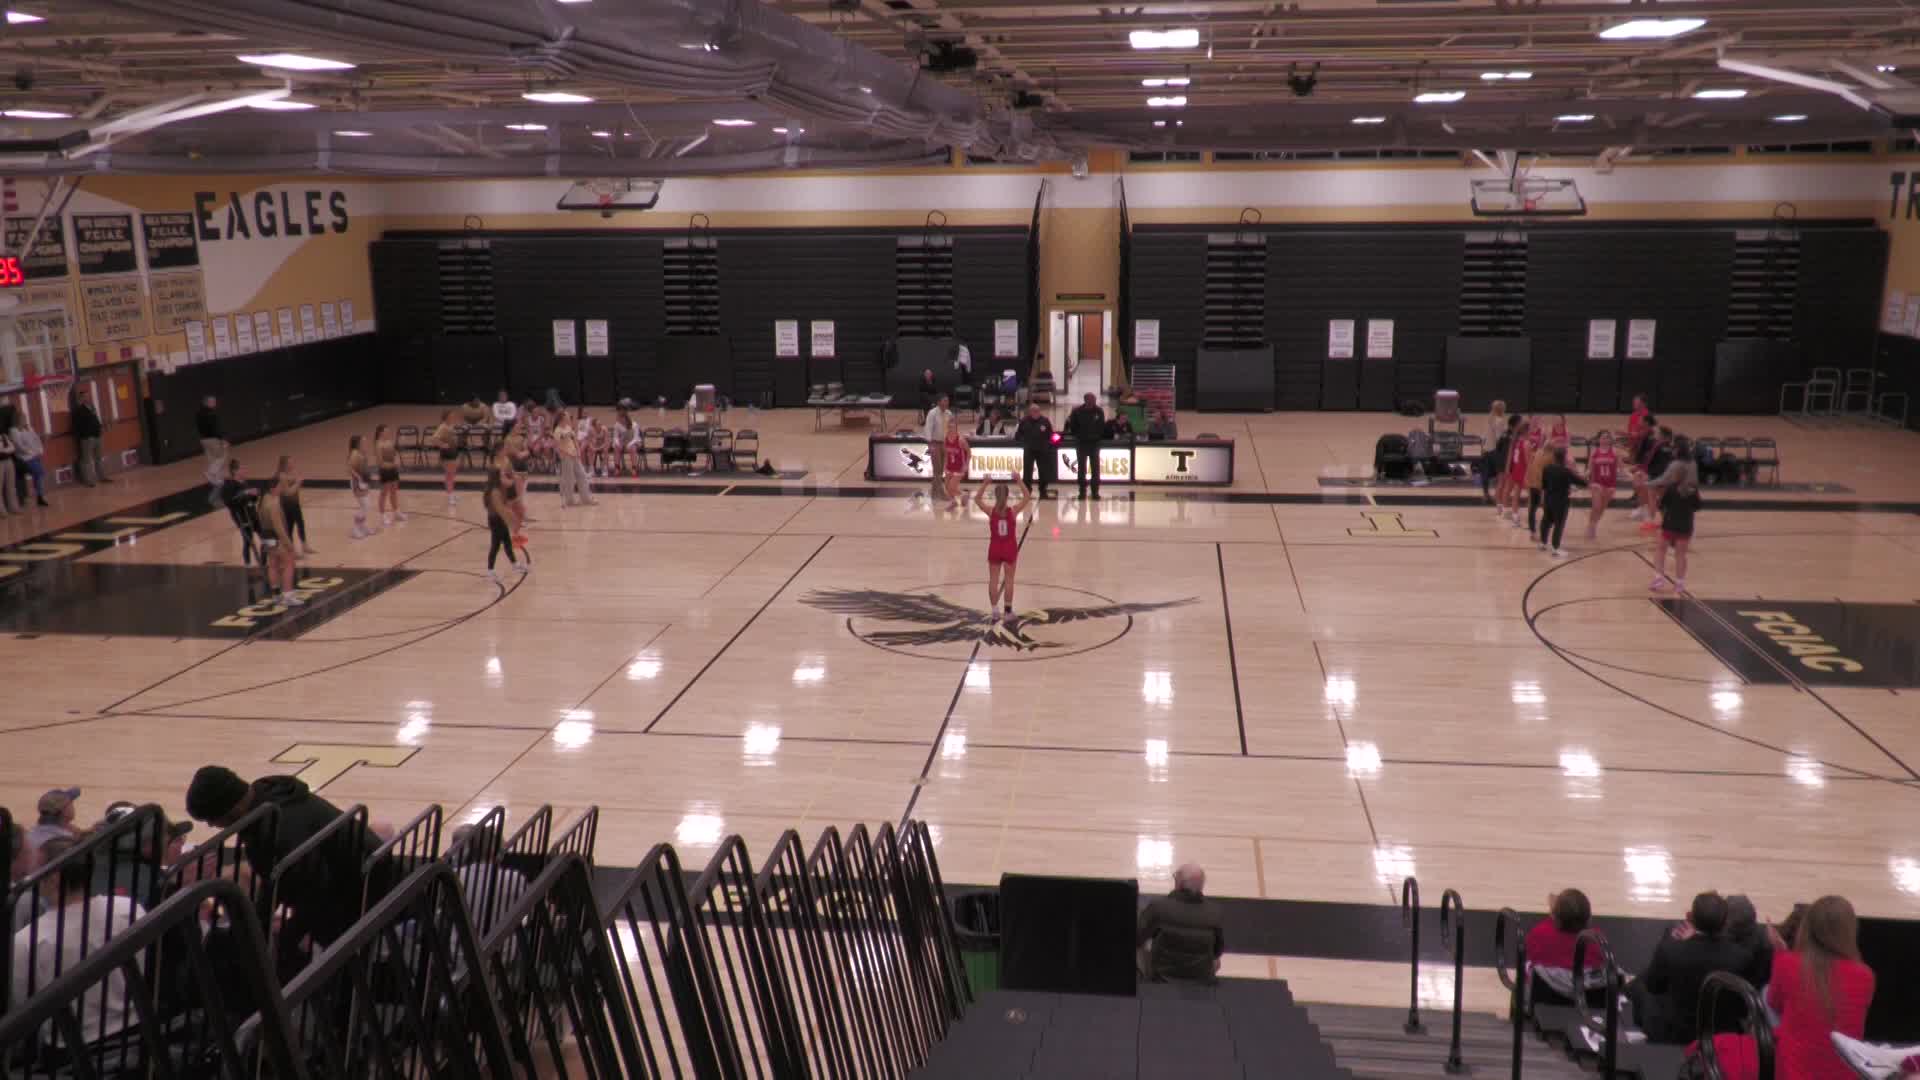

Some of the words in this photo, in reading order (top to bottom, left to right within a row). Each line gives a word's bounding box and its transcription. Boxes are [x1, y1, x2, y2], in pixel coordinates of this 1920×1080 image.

[194, 190, 348, 241] EAGLES
[1169, 449, 1196, 473] T
[997, 519, 1009, 537] 0
[1736, 609, 1864, 674] FCIAC
